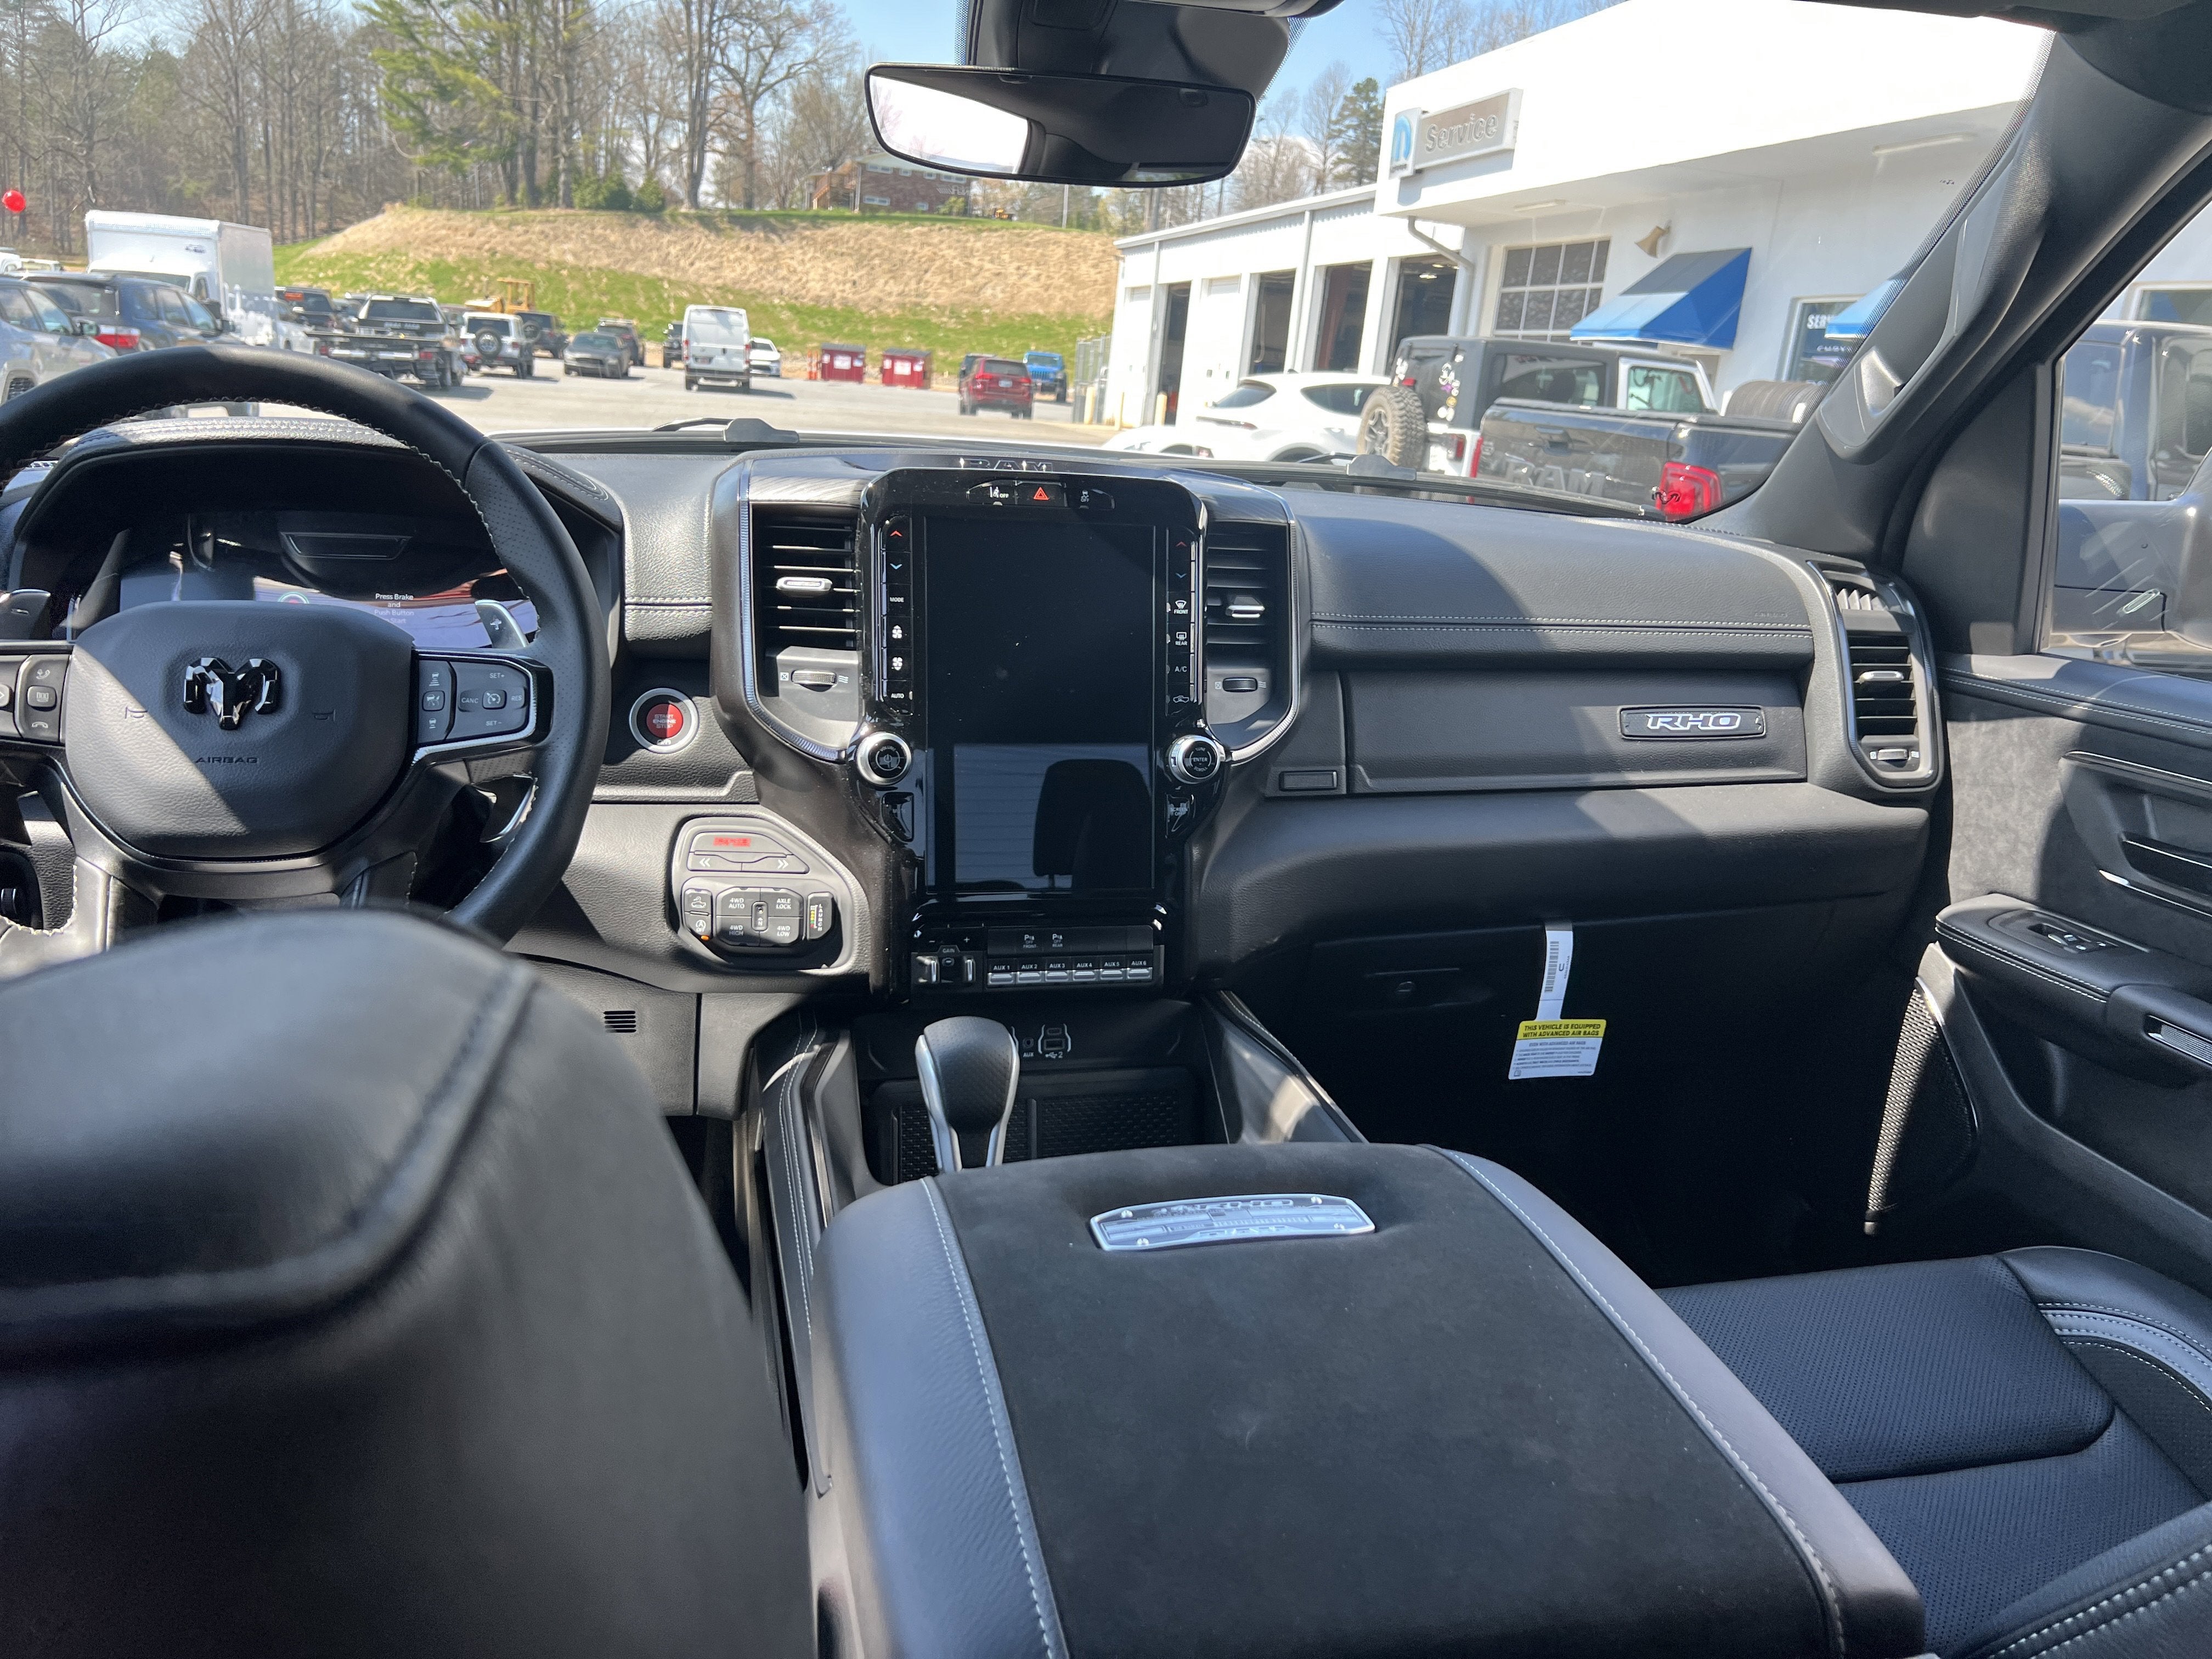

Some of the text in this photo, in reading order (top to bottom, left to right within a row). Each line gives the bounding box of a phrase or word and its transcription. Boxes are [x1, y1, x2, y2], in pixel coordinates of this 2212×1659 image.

[1425, 113, 1498, 154] Service
[1505, 452, 1606, 496] RAM
[1646, 713, 1741, 730] RHO
